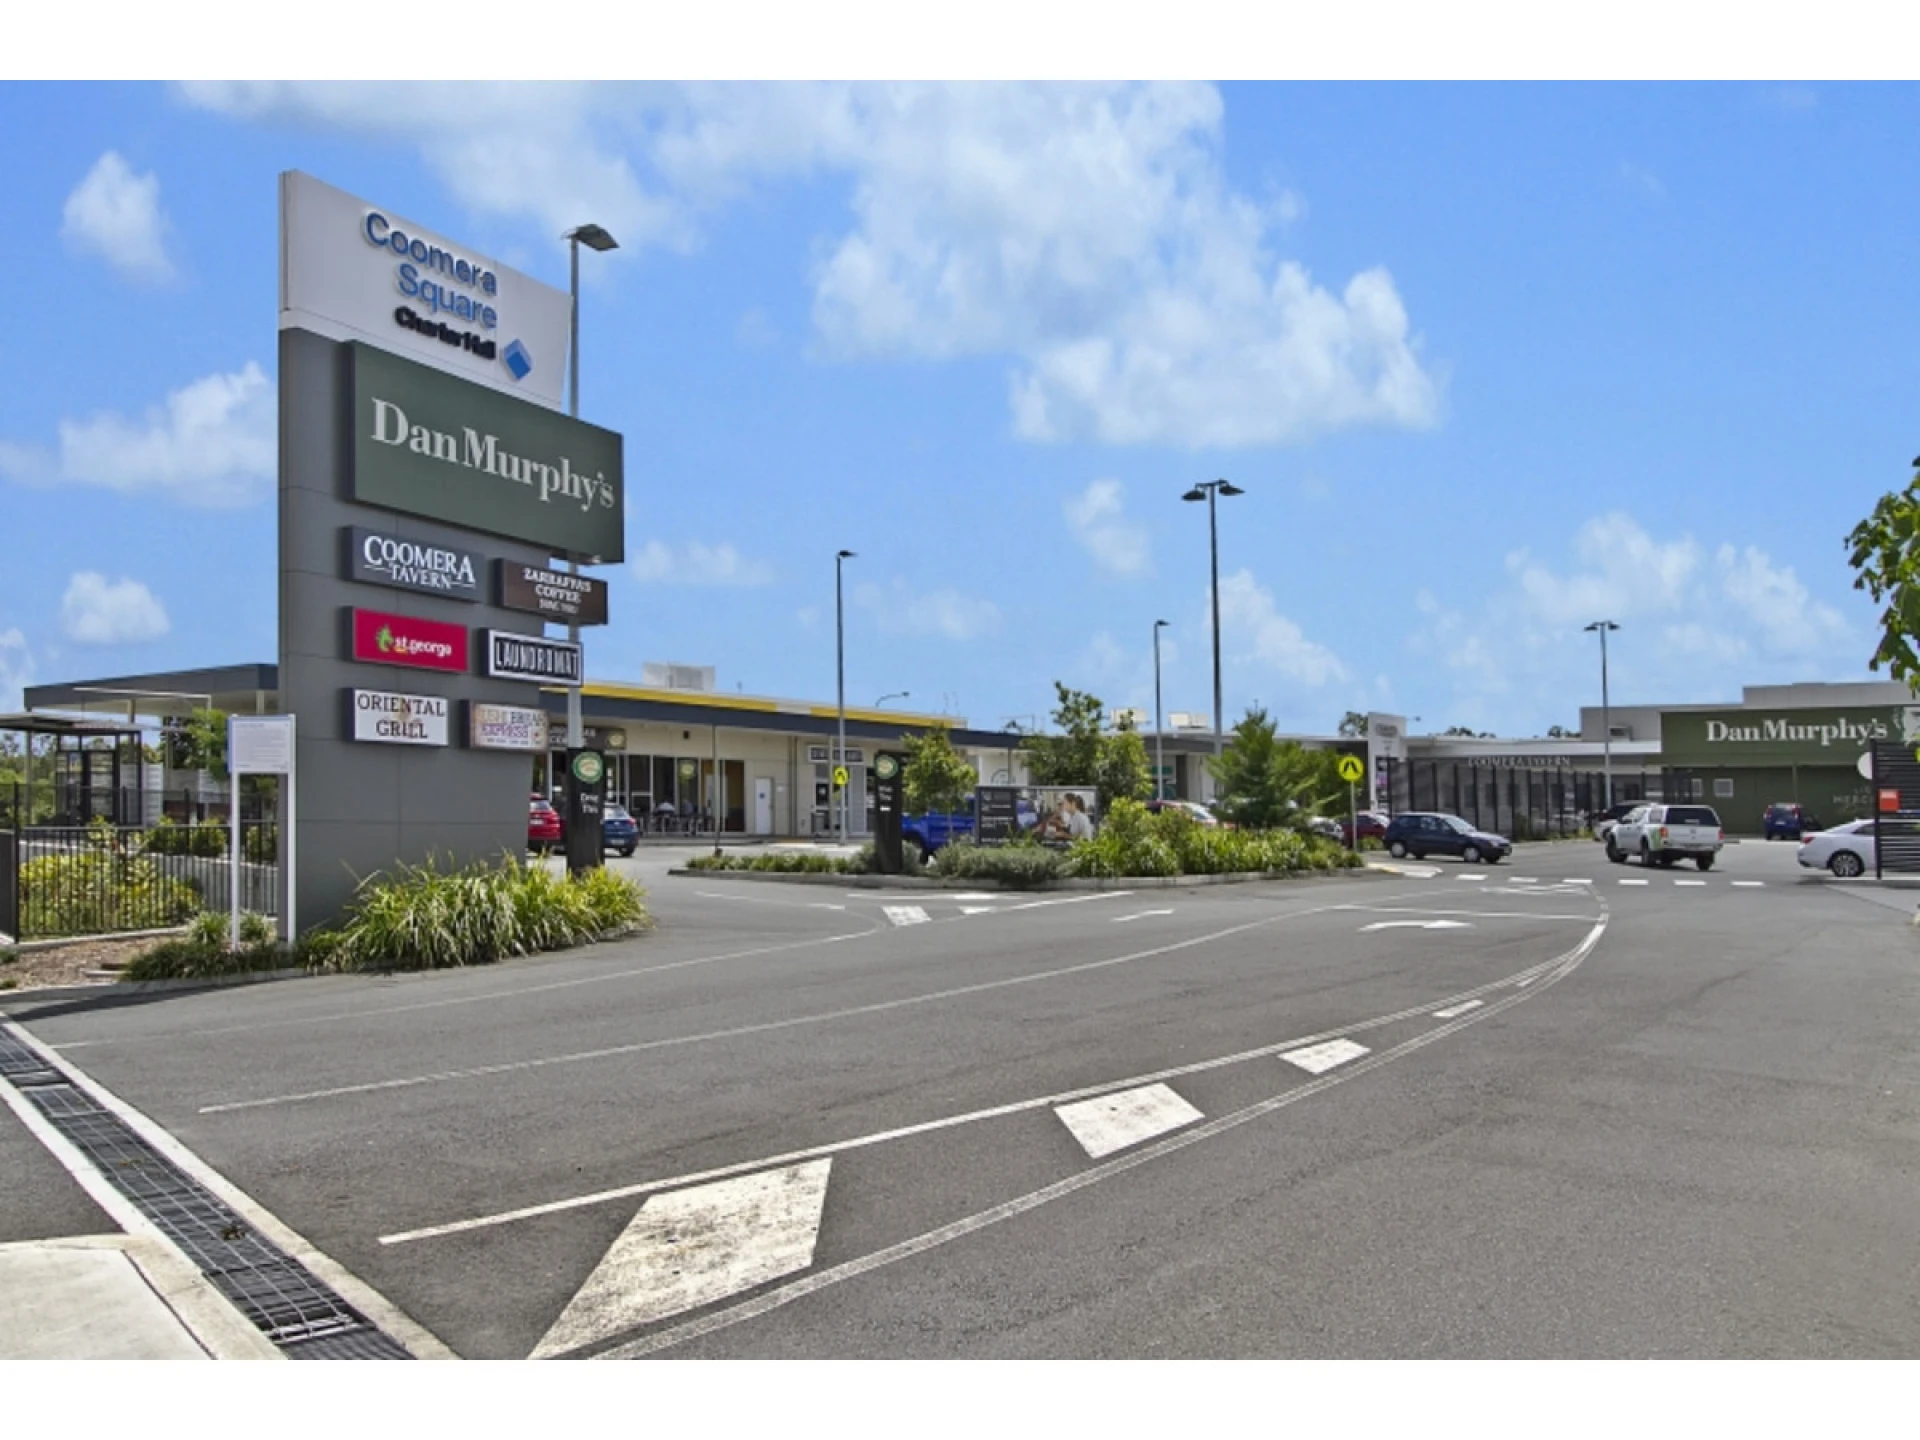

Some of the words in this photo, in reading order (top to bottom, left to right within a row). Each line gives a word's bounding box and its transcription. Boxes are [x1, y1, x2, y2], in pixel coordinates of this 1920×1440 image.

[364, 211, 497, 297] Coomera
[396, 261, 497, 330] Square
[394, 305, 462, 347] Charter
[371, 397, 458, 463] Dan
[462, 426, 615, 512] Murphy's
[364, 535, 476, 583] COOMERA
[390, 564, 451, 589] TAVERN
[496, 641, 577, 675] LAUNDROMAT
[358, 694, 445, 717] ORIENTAL
[376, 719, 428, 738] GRILL
[1706, 720, 1760, 741] Dan
[1762, 718, 1888, 746] Murphy's
